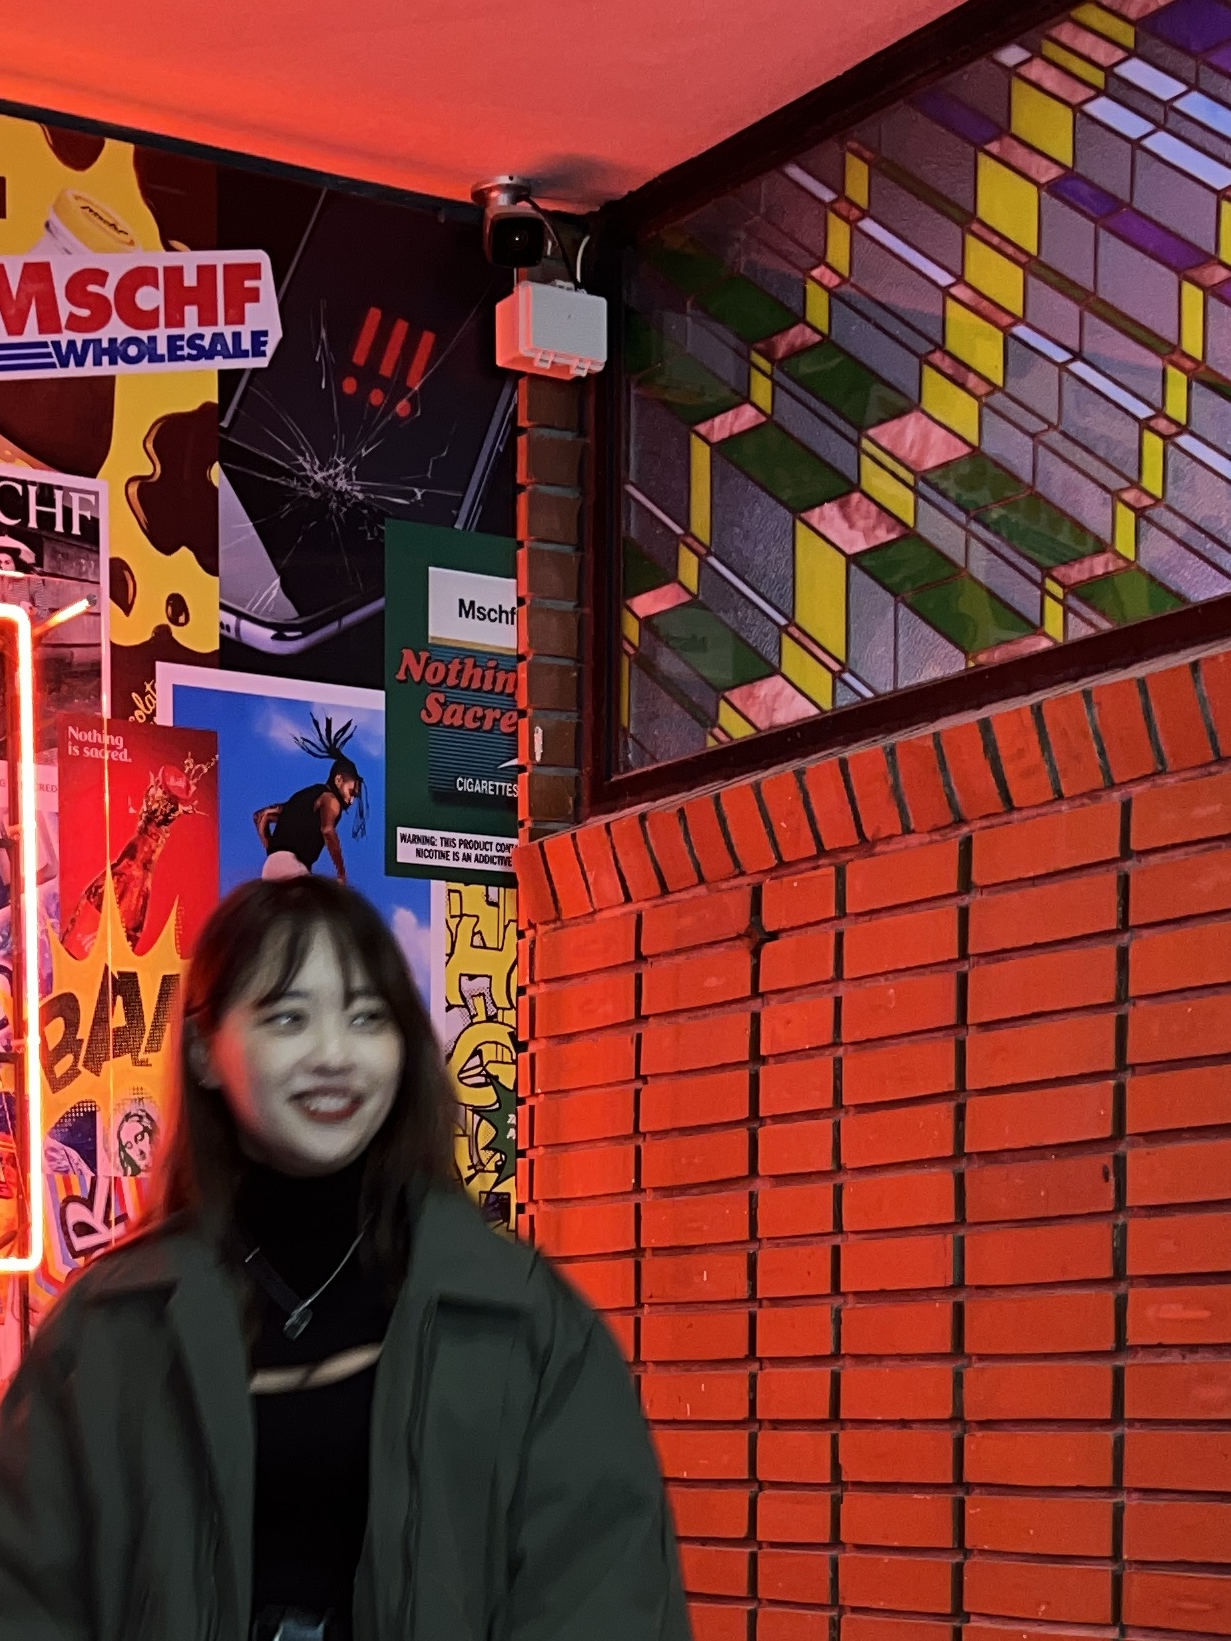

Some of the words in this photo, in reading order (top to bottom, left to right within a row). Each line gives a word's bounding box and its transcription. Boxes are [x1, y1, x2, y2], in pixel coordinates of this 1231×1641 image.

[51, 329, 269, 368] WHOLESALE
[458, 598, 517, 627] Mschf
[395, 647, 519, 702] Nothin
[67, 726, 124, 750] Nothing
[67, 741, 80, 757] is
[455, 776, 519, 798] CIGARETTES
[415, 847, 451, 862] NICOTINE
[452, 850, 460, 862] IS
[461, 851, 472, 863] AN
[439, 836, 457, 849] THIS
[458, 838, 494, 853] PRODUCT
